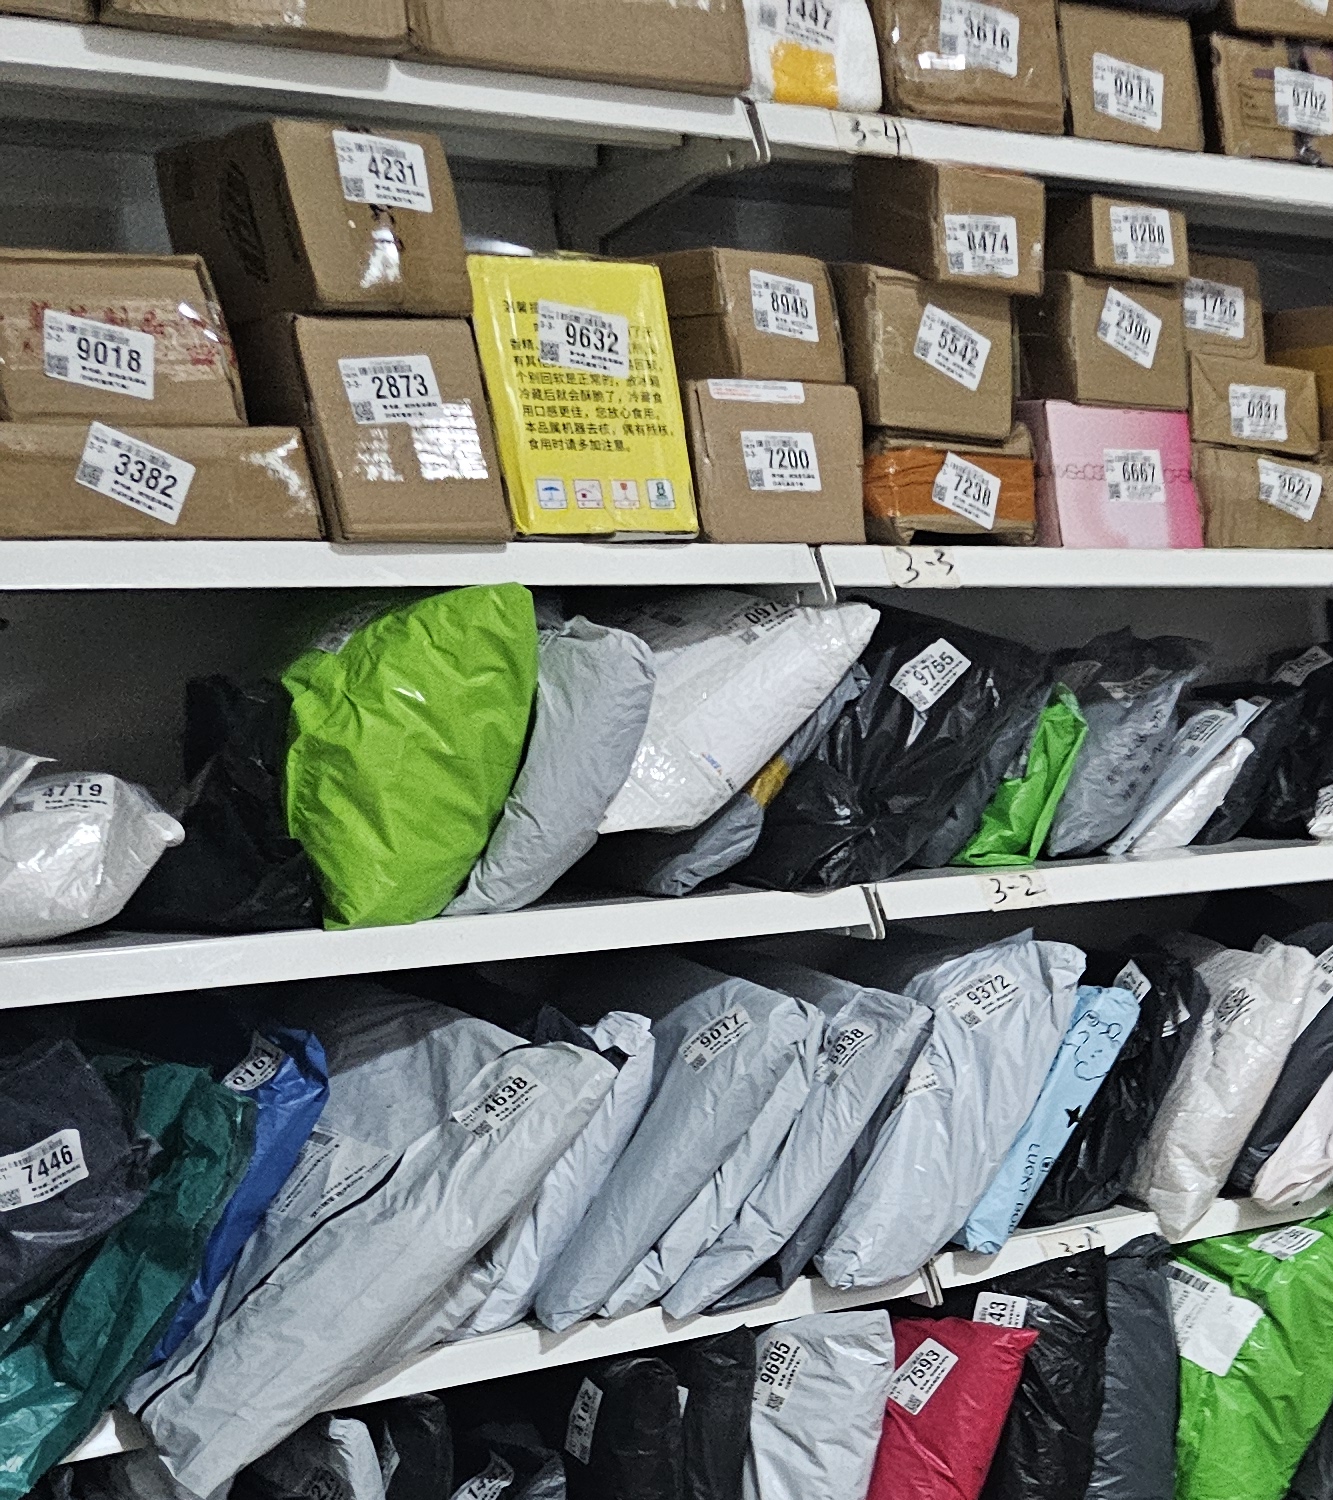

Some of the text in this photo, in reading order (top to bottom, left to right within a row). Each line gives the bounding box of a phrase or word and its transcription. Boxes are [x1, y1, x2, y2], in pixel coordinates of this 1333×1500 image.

[368, 156, 418, 187] 4231
[78, 337, 142, 372] 9018
[566, 322, 619, 355] 9632
[371, 374, 430, 400] 2873
[114, 453, 178, 500] 3382
[895, 546, 955, 585] 3-3
[42, 783, 104, 799] 4719
[989, 874, 1047, 904] 3-2
[966, 974, 1010, 1005] 9372
[700, 1014, 741, 1049] 9017
[484, 1076, 528, 1116] 4638
[21, 1143, 73, 1185] 7446
[1020, 1143, 1041, 1194] LUCKY
[760, 1340, 790, 1385] 9695
[904, 1349, 941, 1388] 7593
